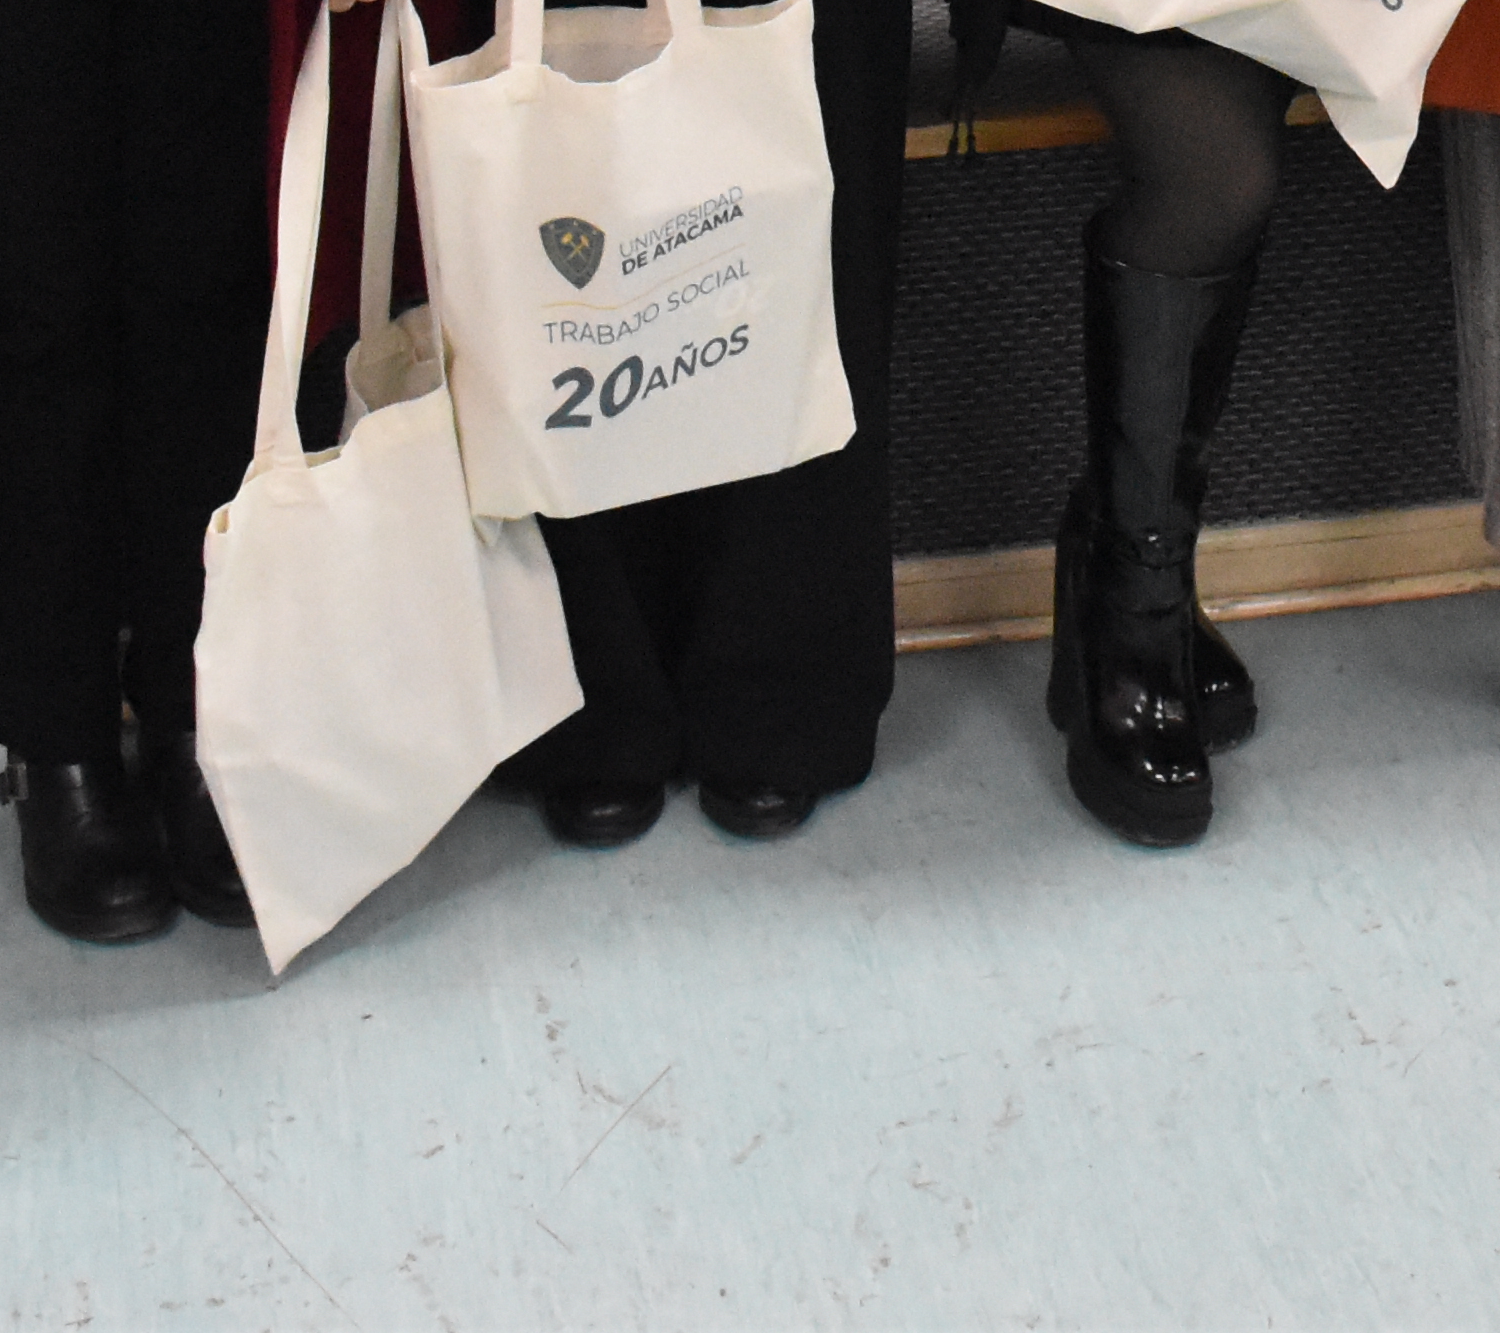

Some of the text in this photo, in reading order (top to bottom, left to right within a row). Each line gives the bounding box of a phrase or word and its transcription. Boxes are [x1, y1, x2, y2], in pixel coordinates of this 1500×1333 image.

[618, 185, 744, 259] UNIVERSIDAD
[621, 204, 744, 276] DE ATACAMA
[543, 258, 750, 346] TRABAJO SOCIAL
